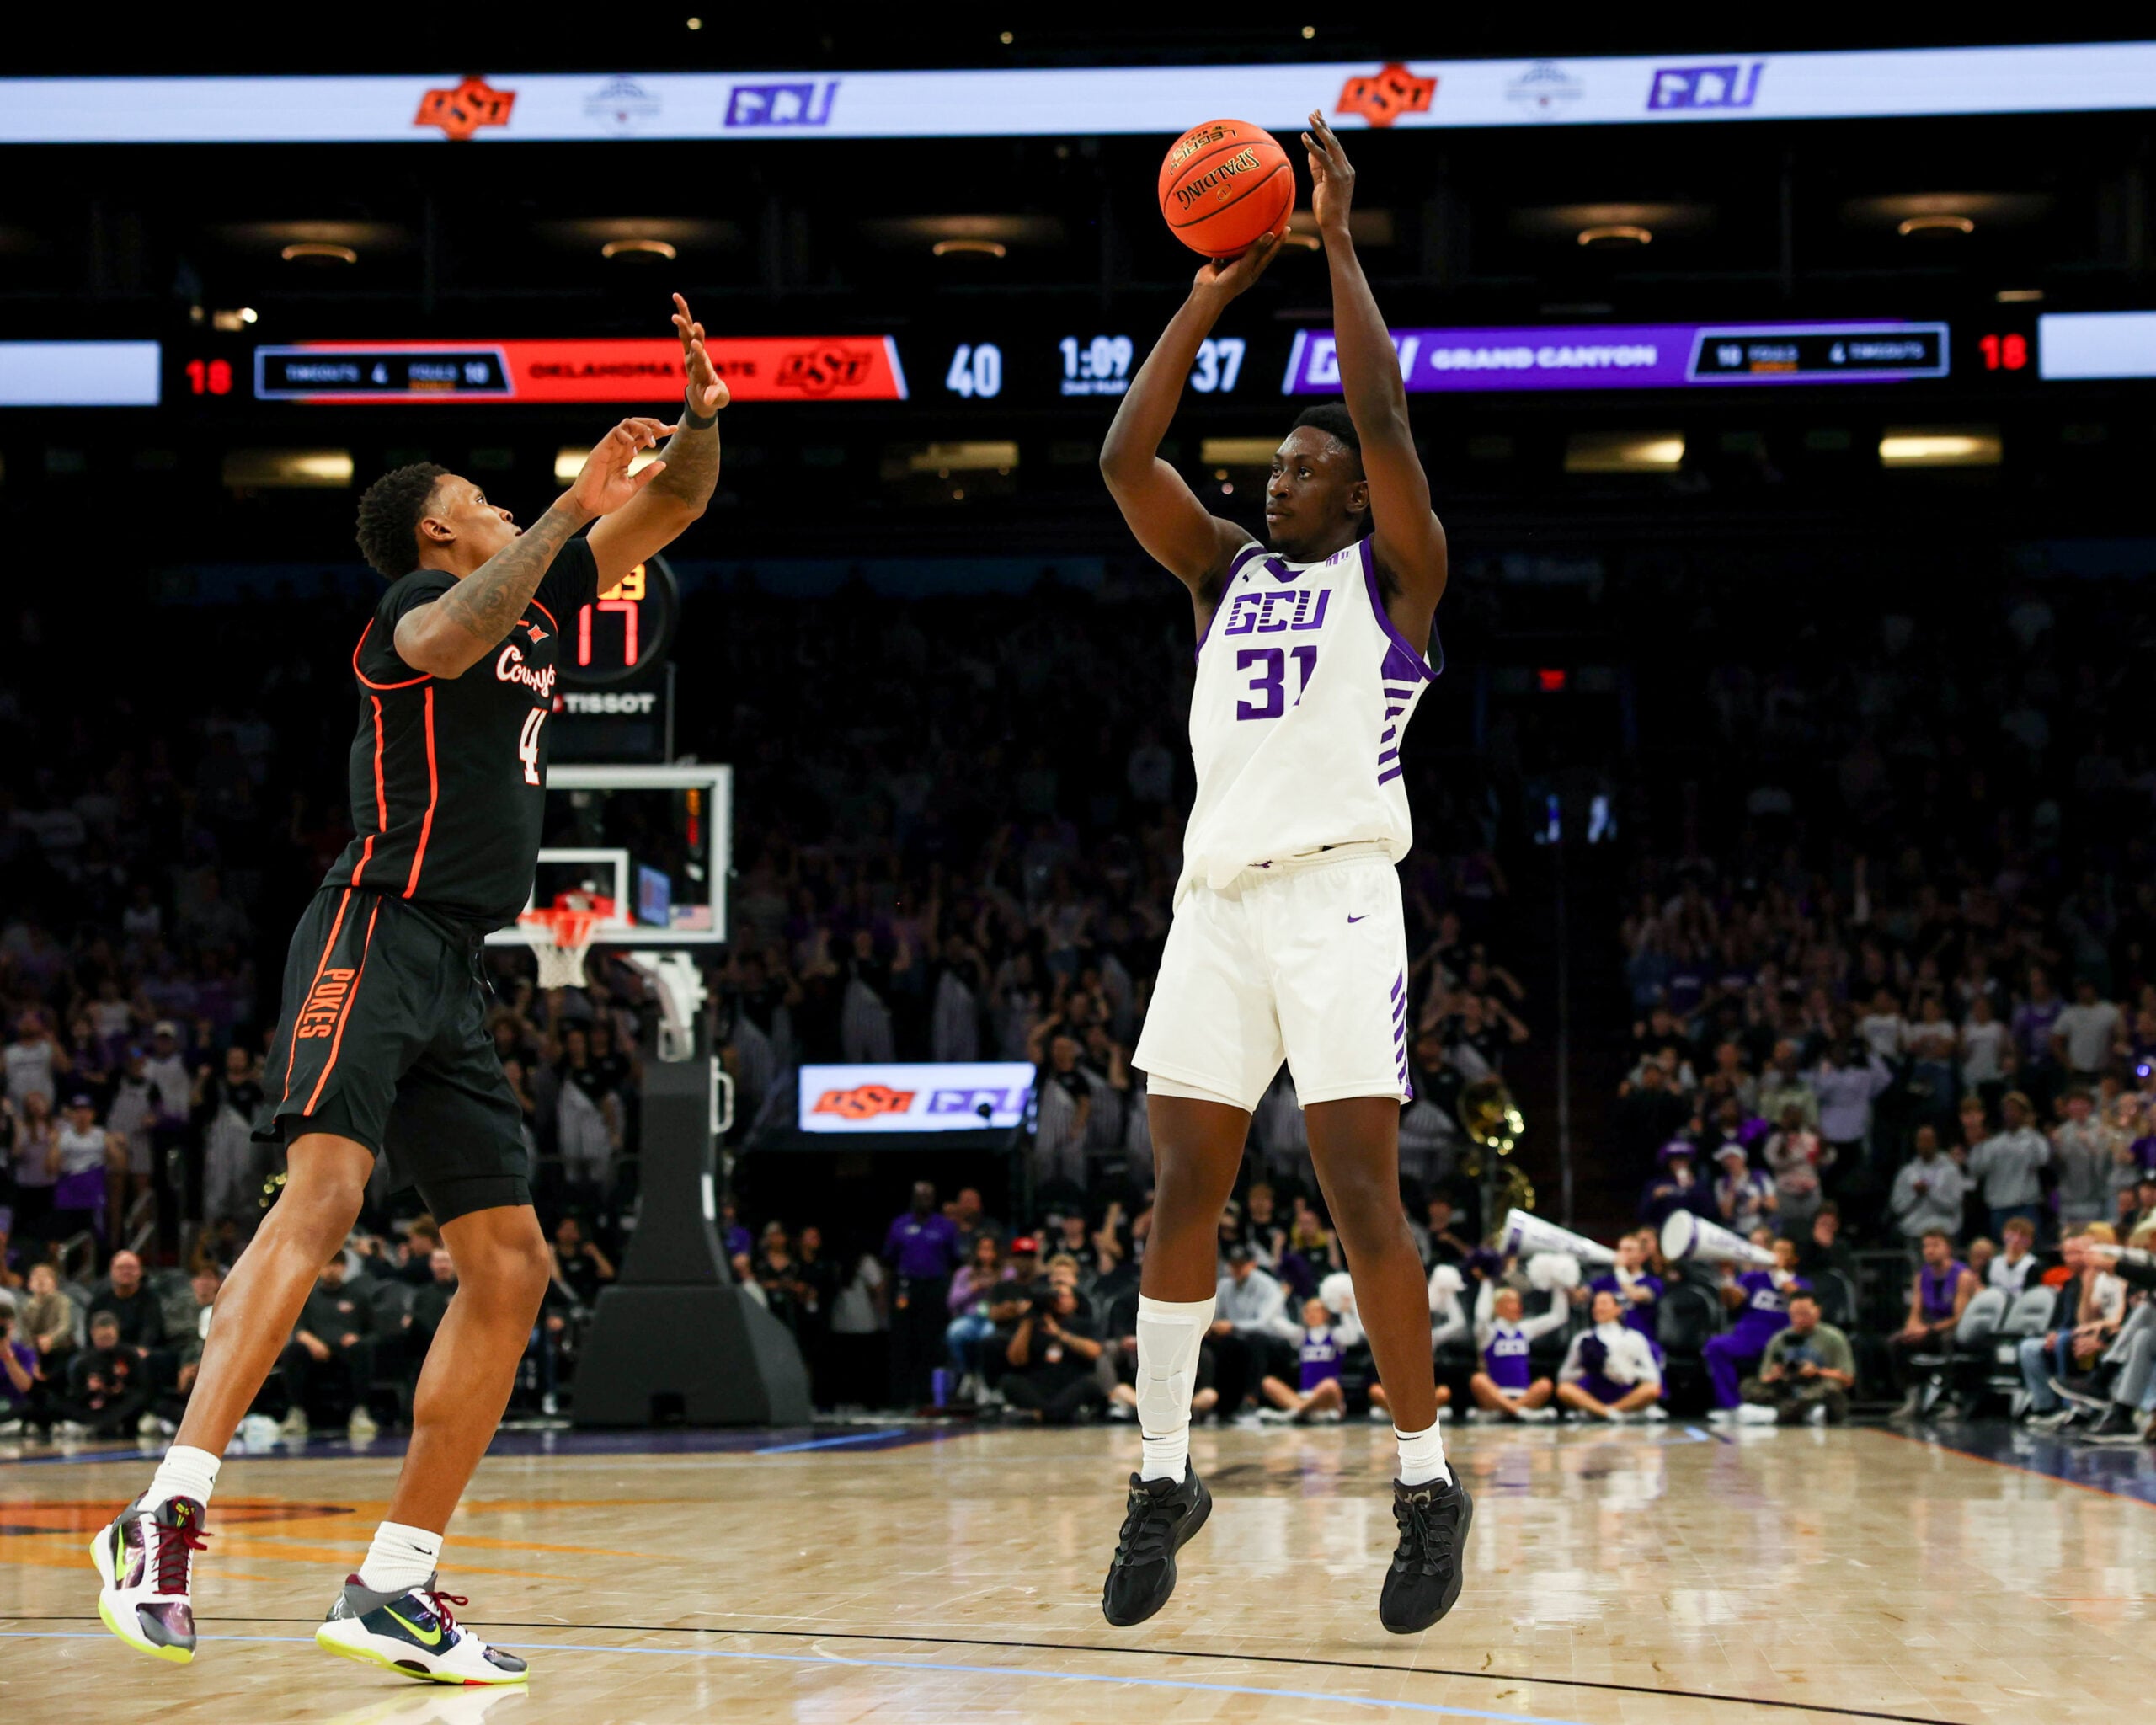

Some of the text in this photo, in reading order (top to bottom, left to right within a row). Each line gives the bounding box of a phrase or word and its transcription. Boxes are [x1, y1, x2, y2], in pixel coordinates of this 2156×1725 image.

[1175, 147, 1260, 211] SPALDING
[529, 362, 673, 379] OKLAHOMA
[947, 344, 1002, 398] 40
[1059, 336, 1132, 379] 1:09
[1191, 338, 1245, 393] 37
[1431, 345, 1657, 371] GRAND CANYON
[578, 599, 638, 667] 17
[1224, 589, 1333, 636] GCU
[563, 692, 656, 714] TISSOT
[1236, 644, 1318, 721] 31
[518, 706, 548, 786] 4
[297, 968, 356, 1039] POKES
